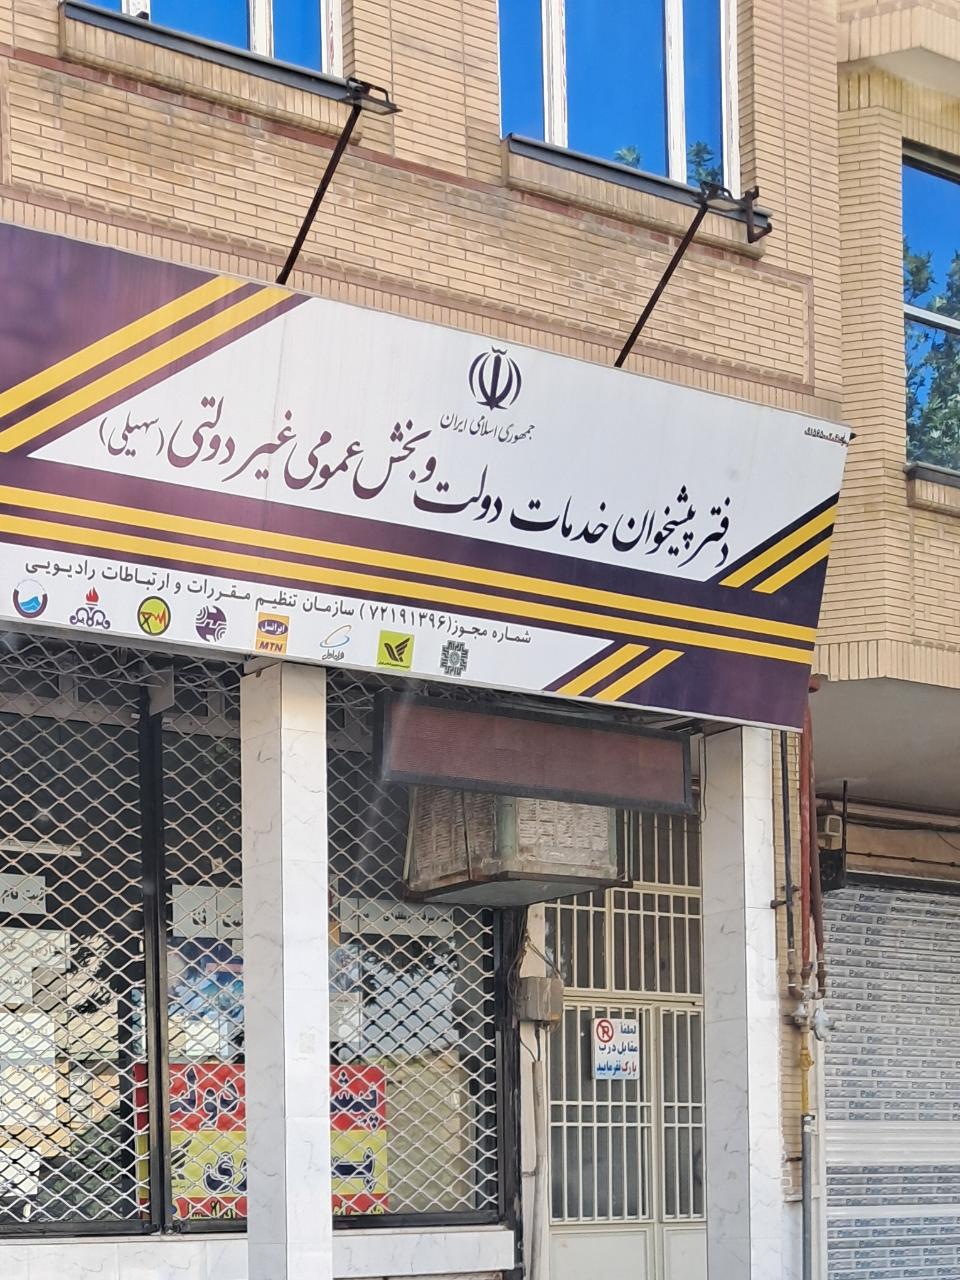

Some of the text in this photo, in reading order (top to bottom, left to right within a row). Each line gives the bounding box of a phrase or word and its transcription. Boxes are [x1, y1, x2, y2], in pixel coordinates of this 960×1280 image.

[167, 396, 235, 468] دولتی
[440, 413, 535, 444] جمهوری اسلامی ایران
[221, 410, 297, 482] غیر
[284, 430, 364, 490] عمومی
[353, 419, 432, 500] بخش
[418, 456, 437, 483] و
[413, 464, 502, 524] دولت
[509, 496, 609, 544] خدمات
[611, 484, 697, 557] پیشخوان
[677, 497, 730, 569] دفتر
[25, 560, 96, 581] رادیویی
[102, 565, 170, 595] ارتباطات
[174, 581, 181, 594] و
[187, 577, 250, 602] مقررات
[255, 590, 296, 611] تنظیم
[302, 599, 354, 618] سازمان
[259, 641, 283, 652] MTN
[492, 626, 531, 645] شماره
[599, 1041, 638, 1055] مقابل درب
